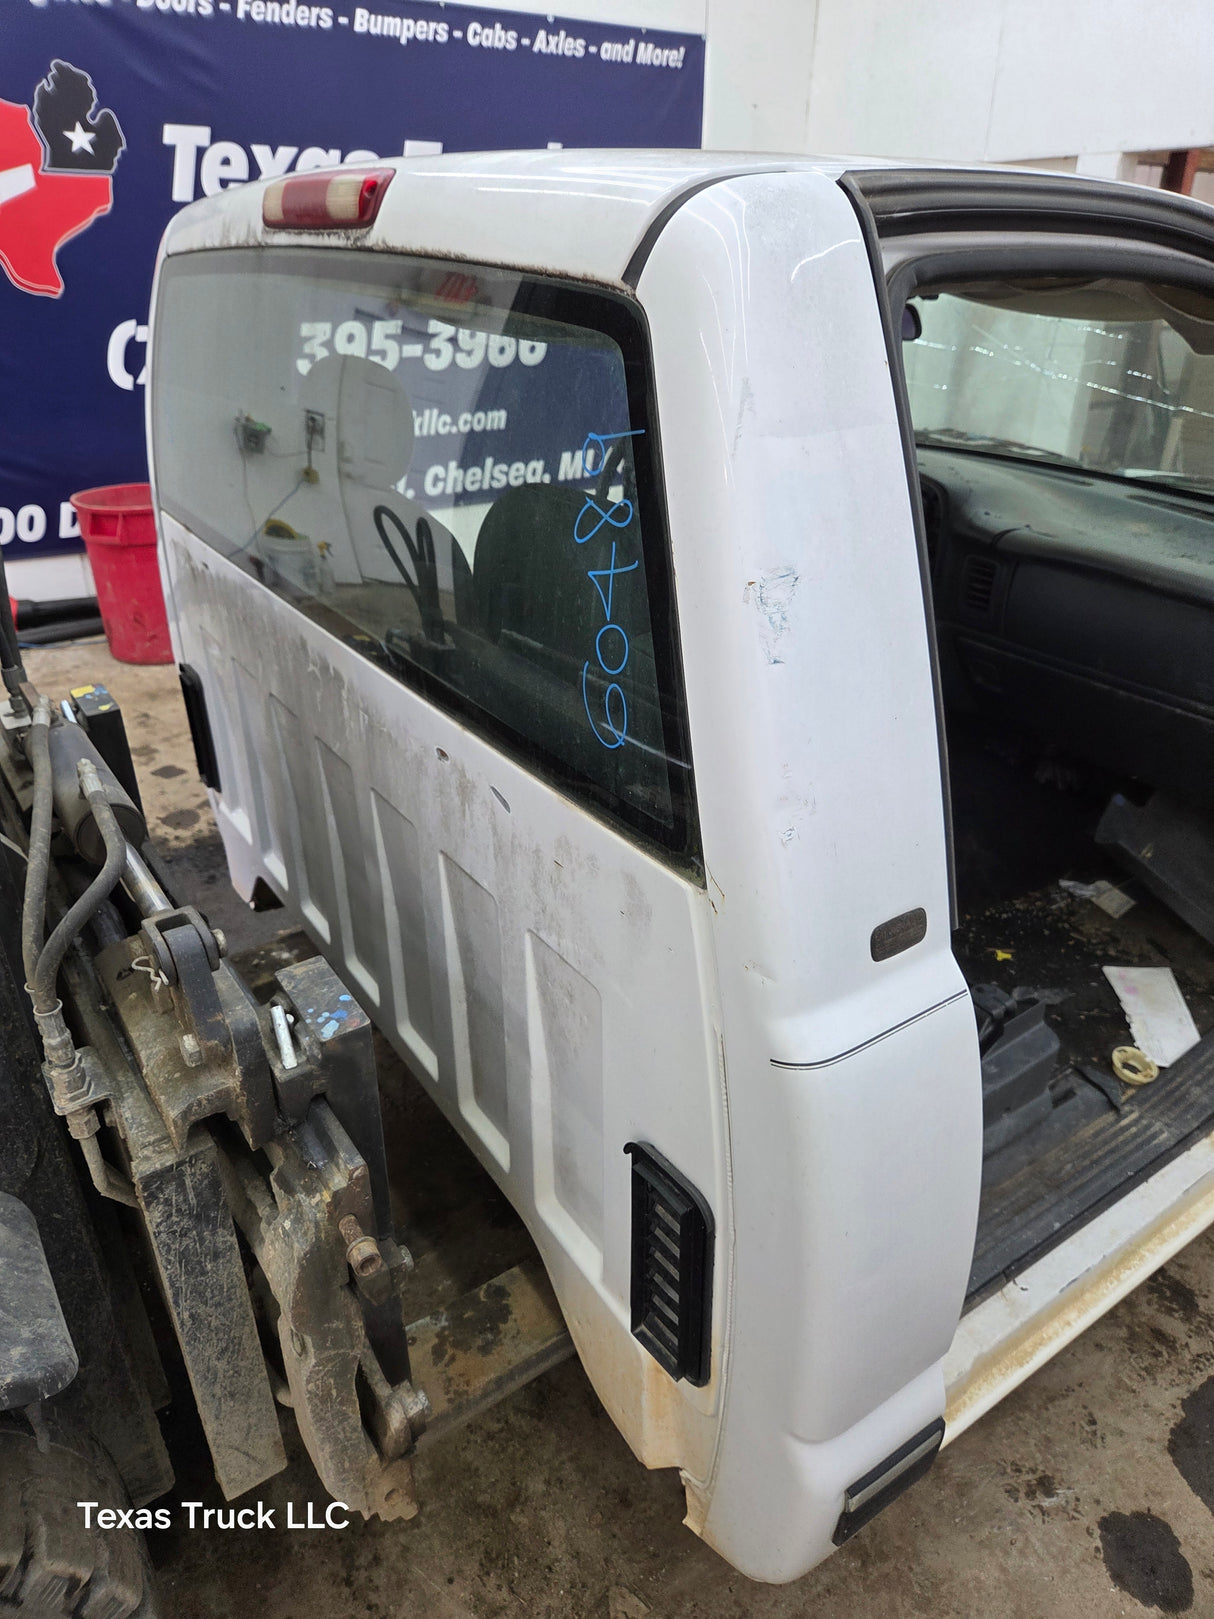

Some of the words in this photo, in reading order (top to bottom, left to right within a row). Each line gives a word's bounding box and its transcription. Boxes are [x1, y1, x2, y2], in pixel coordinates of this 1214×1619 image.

[236, 0, 334, 28] Fenders
[353, 8, 449, 44] Bumpers
[466, 22, 518, 49] Cabs
[532, 29, 586, 57] Axles
[600, 39, 634, 63] and
[636, 42, 686, 68] More!
[574, 432, 645, 748] 60489
